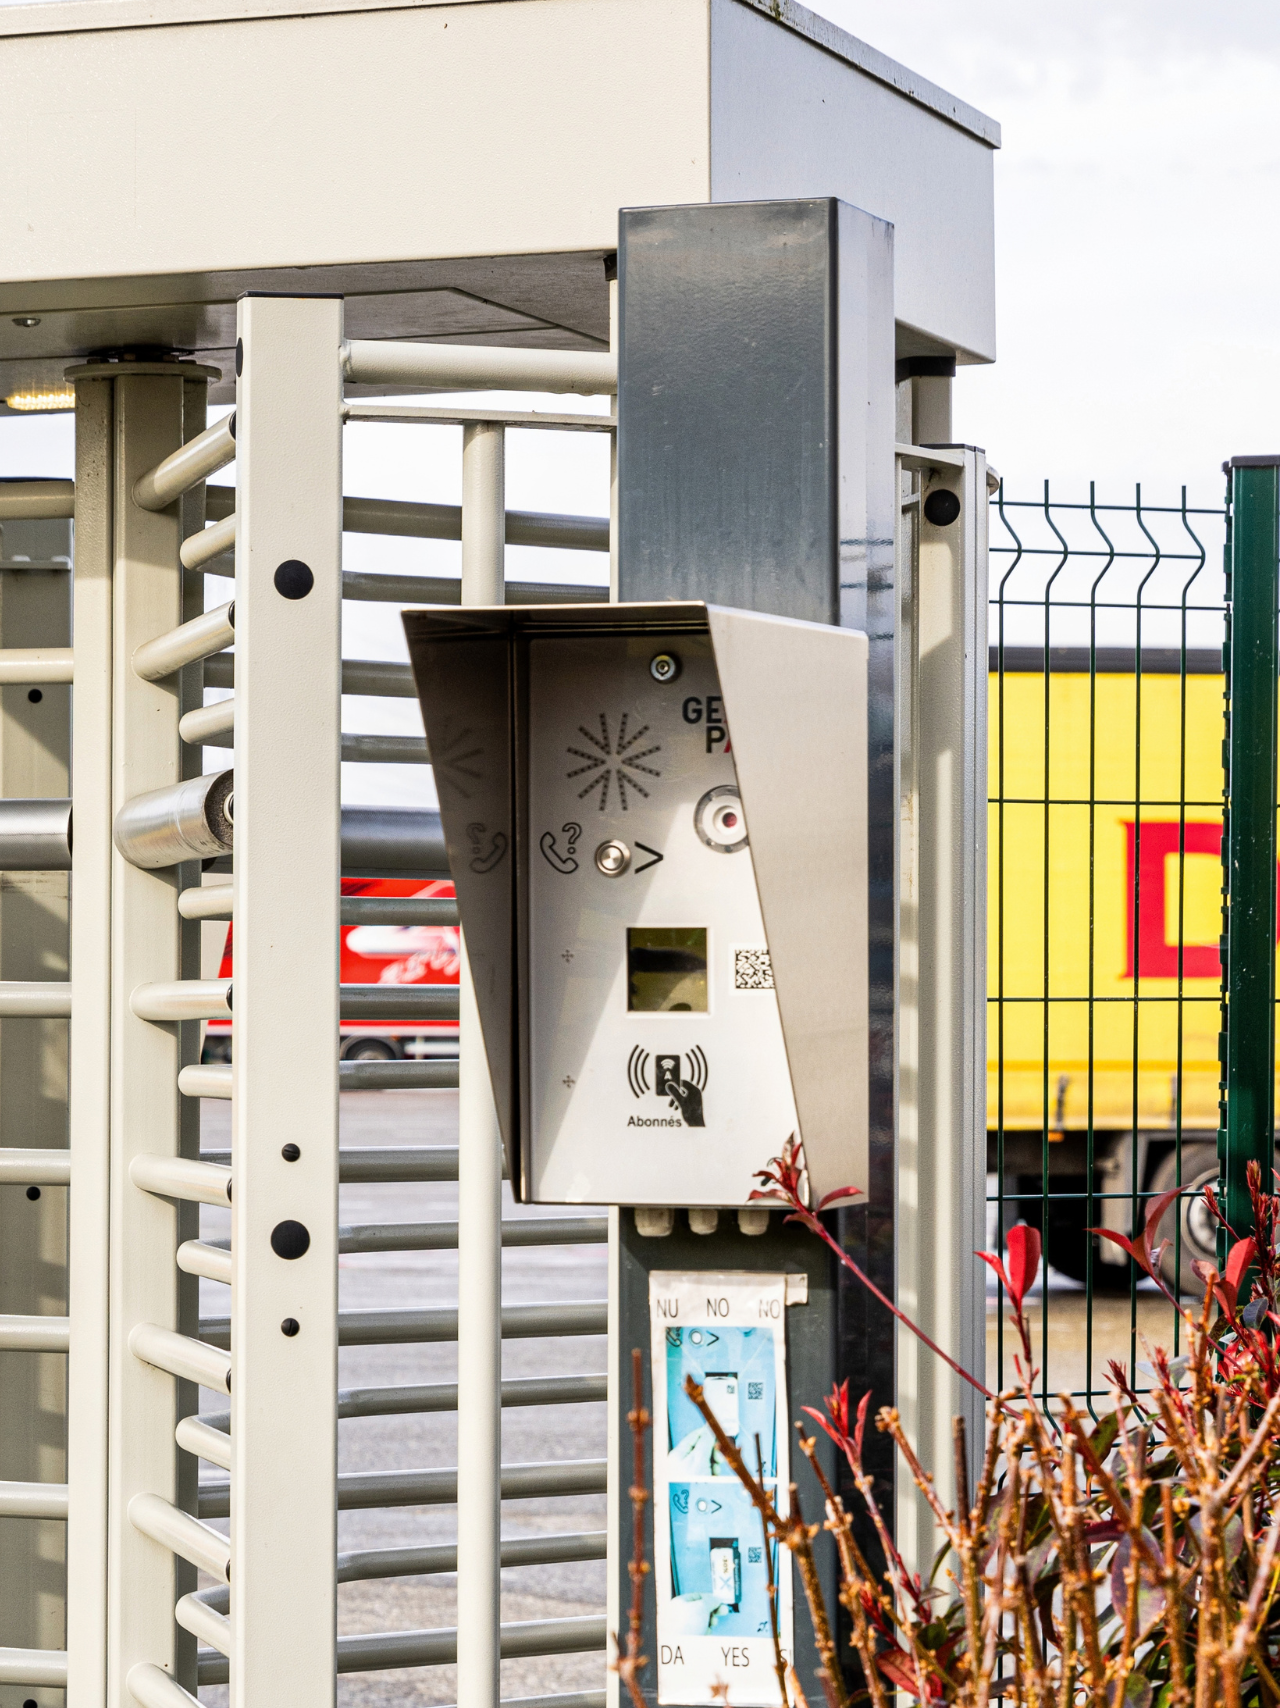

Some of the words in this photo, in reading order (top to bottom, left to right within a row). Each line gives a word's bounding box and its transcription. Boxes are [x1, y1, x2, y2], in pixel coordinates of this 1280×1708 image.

[682, 696, 727, 724] GE
[627, 1115, 682, 1127] Abonnés
[657, 1298, 679, 1318] NU
[707, 1298, 730, 1318] NO
[759, 1299, 780, 1319] NO
[661, 1645, 684, 1665] DA
[721, 1647, 750, 1667] YES
